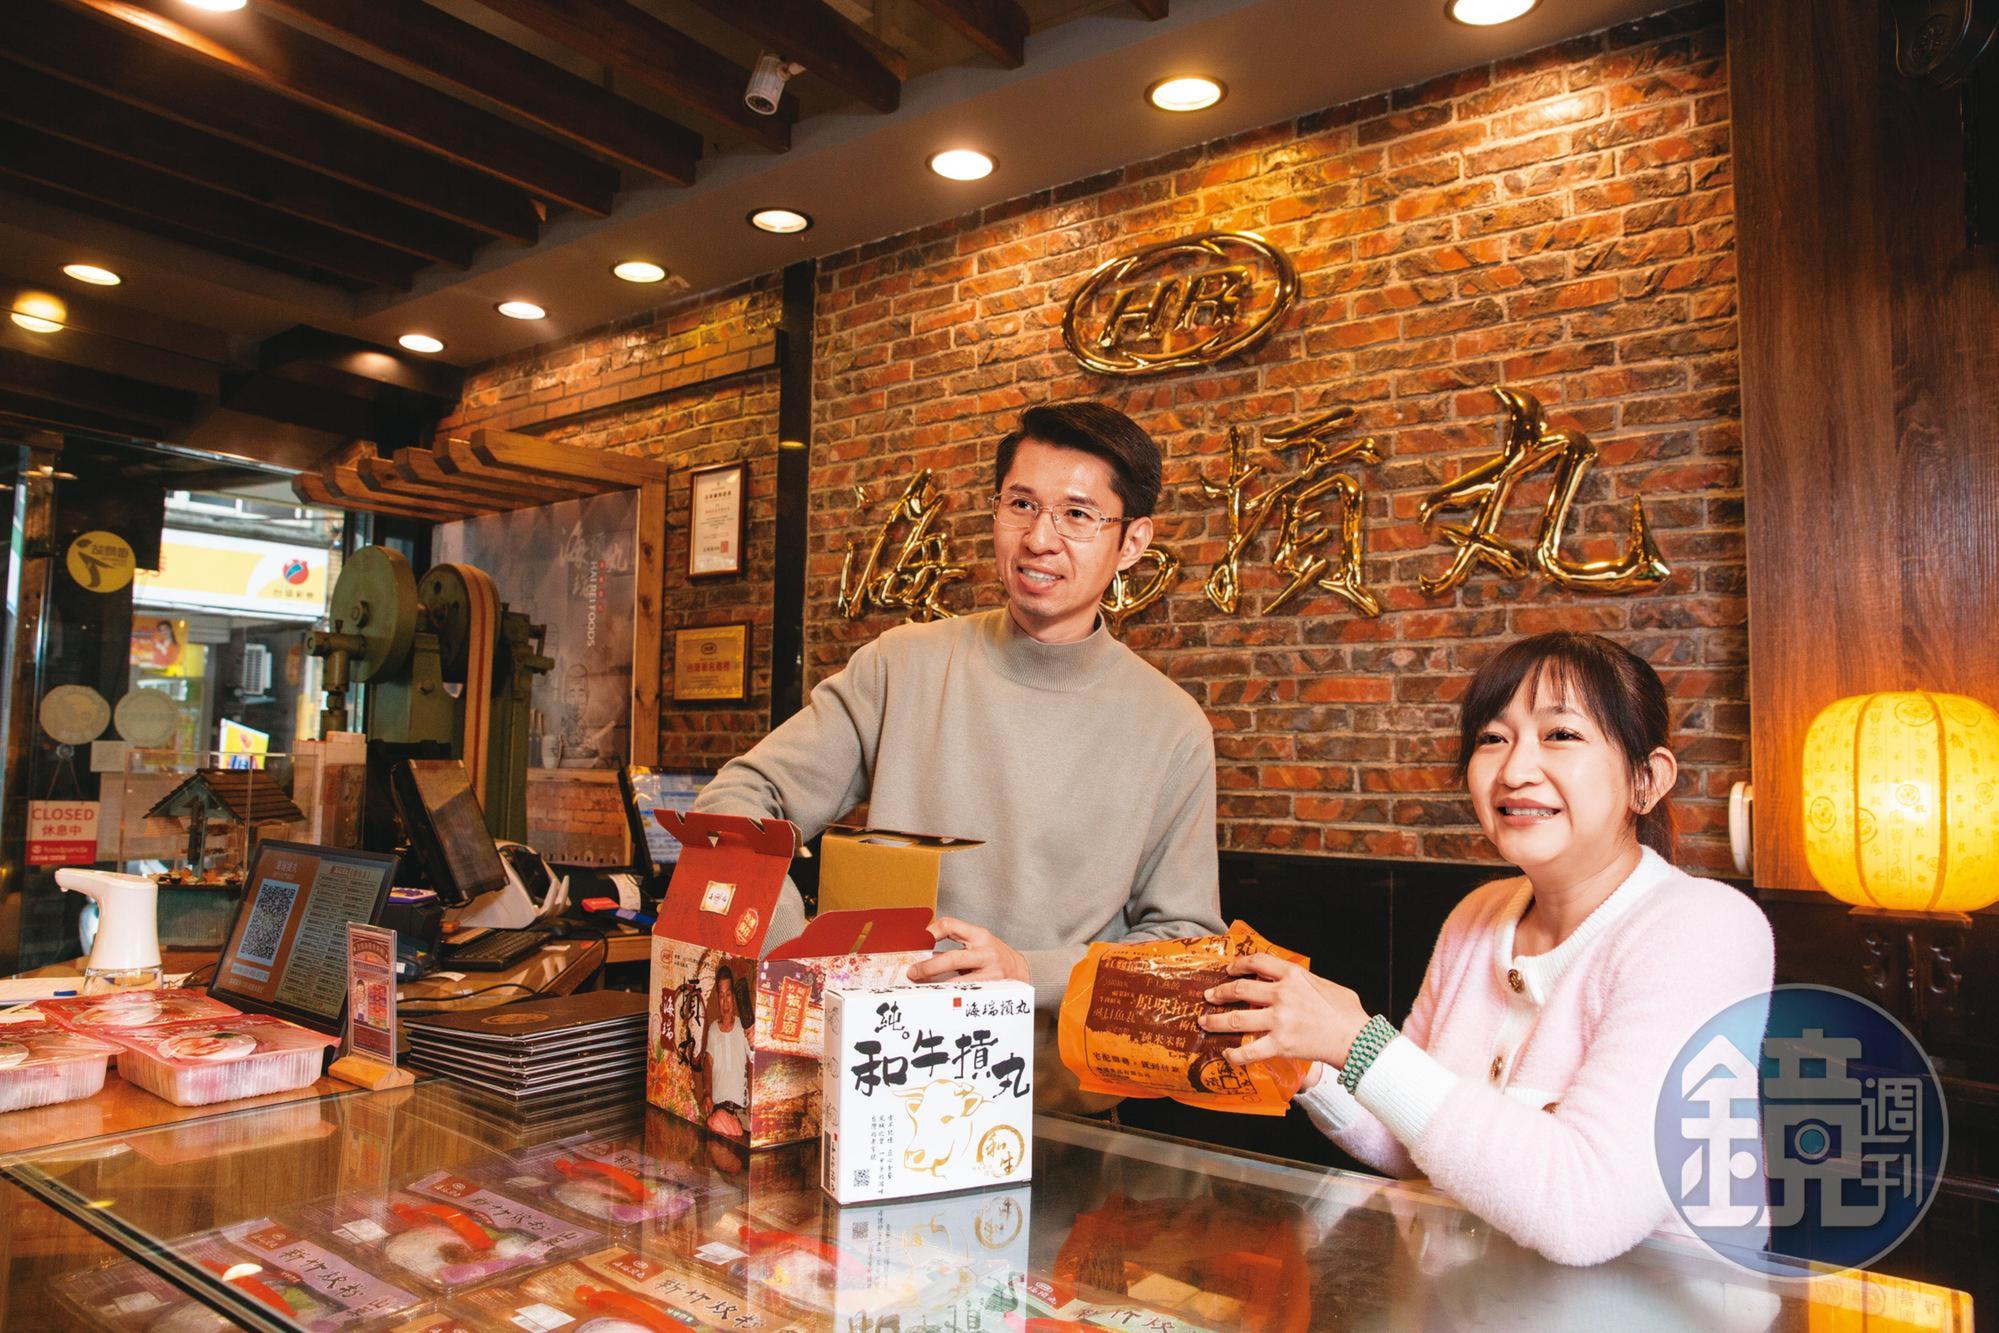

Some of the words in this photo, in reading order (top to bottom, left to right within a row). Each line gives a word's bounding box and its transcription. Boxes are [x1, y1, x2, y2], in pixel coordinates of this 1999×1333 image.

[1097, 265, 1253, 348] HR
[837, 385, 1672, 620] 海摃丸
[31, 807, 95, 821] CLOSED
[42, 825, 82, 836] 休息中
